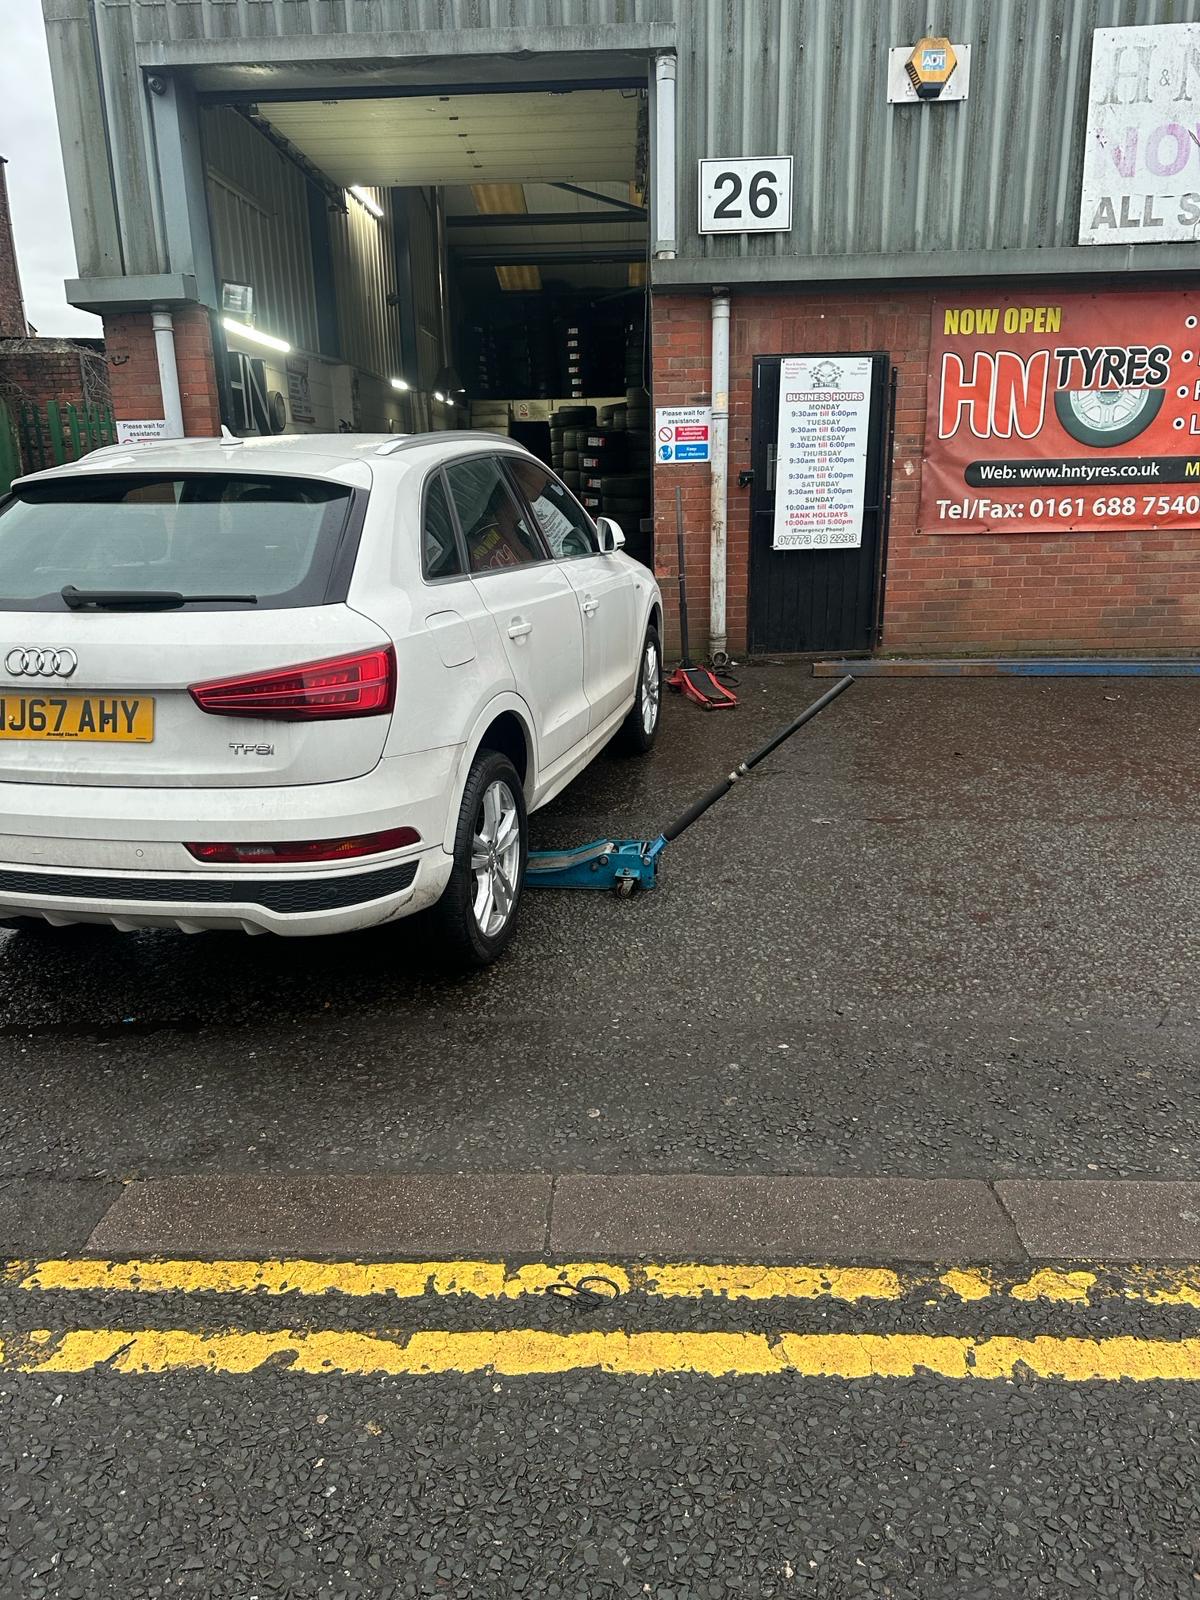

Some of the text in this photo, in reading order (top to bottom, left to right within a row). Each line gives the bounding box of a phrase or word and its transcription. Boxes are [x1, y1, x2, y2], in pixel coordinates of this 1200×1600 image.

[922, 54, 946, 66] ADT
[1093, 122, 1200, 178] NO
[713, 170, 778, 219] 26
[1090, 195, 1163, 229] ALL
[944, 307, 1062, 335] NOW OPEN
[786, 392, 864, 402] BUSINESS HOURS
[938, 344, 1172, 440] HN TYRES
[828, 472, 853, 480] 6:00pm
[980, 465, 1017, 479] Web:
[1020, 462, 1160, 481] www.hntyres.co.uk
[936, 495, 1200, 519] Tel/Fax: 0161 688 7540
[778, 533, 857, 545] 07773 48 2233
[78, 700, 140, 733] AHY
[229, 743, 274, 755] TFSI
